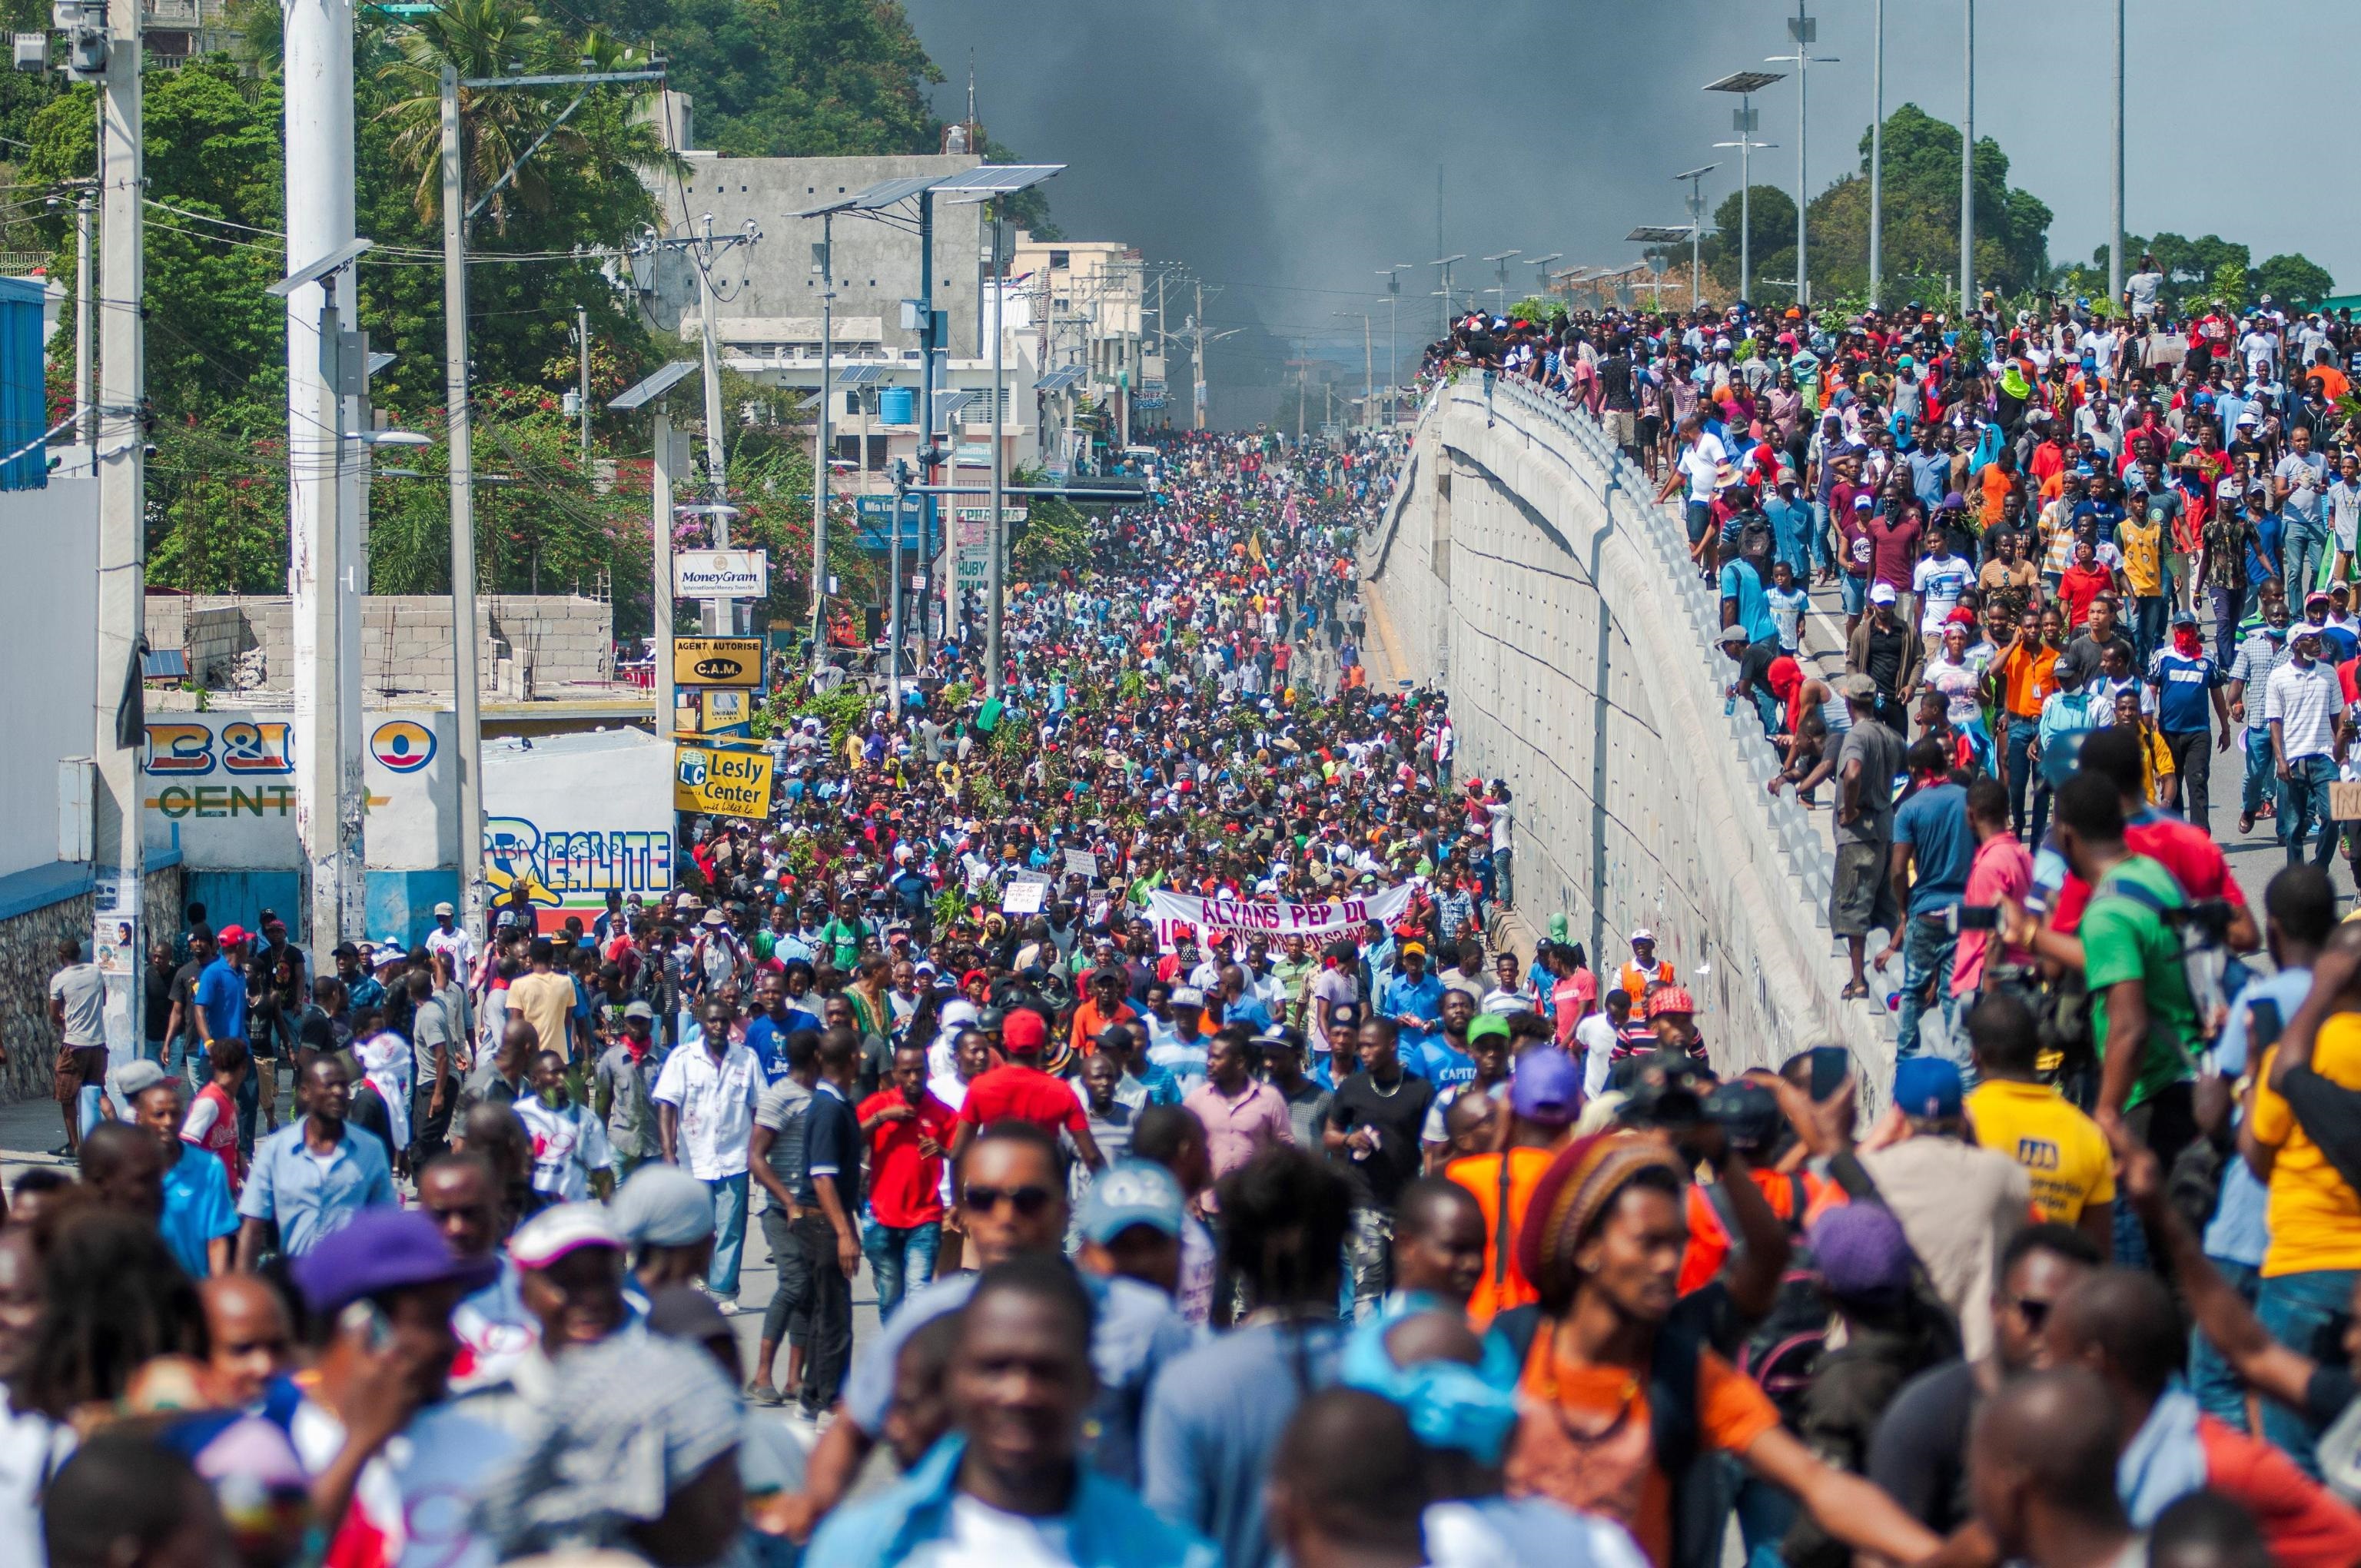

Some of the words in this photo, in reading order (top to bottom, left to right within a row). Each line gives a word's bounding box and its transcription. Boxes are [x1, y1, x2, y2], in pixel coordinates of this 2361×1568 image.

[1134, 399, 1164, 409] POLO
[958, 561, 988, 576] HUBY
[682, 571, 758, 585] MoneyGram
[677, 642, 708, 650] AGENT
[712, 642, 759, 651] AUTORISE
[697, 663, 739, 675] C.A.M.
[711, 753, 764, 786] Lesly
[704, 781, 762, 803] Center
[1202, 899, 1280, 929] ALYANS
[1290, 905, 1333, 929] PEP
[1343, 900, 1370, 922] DI
